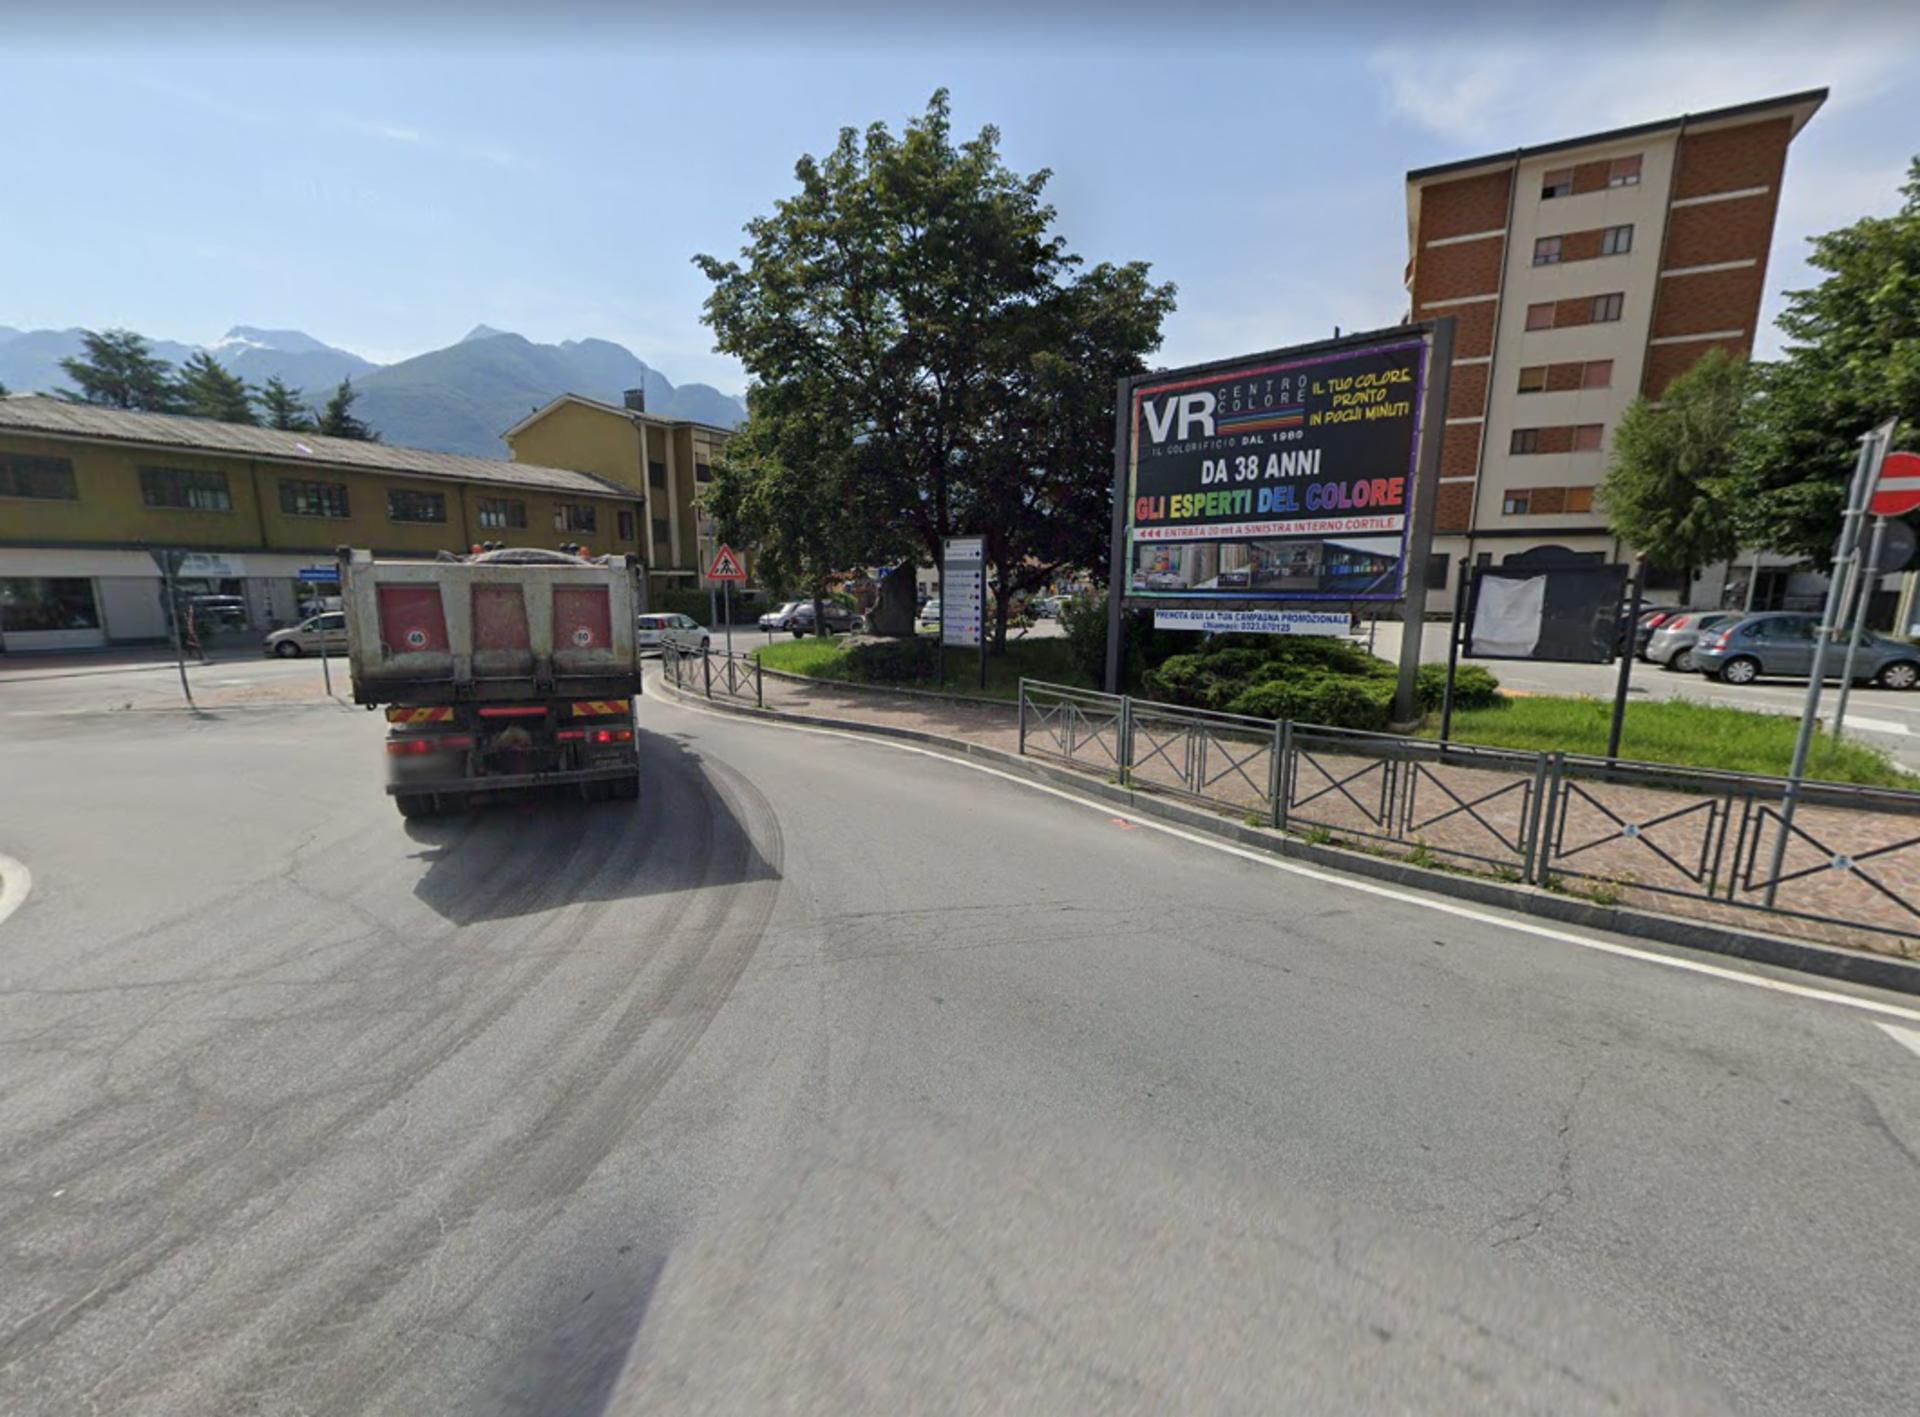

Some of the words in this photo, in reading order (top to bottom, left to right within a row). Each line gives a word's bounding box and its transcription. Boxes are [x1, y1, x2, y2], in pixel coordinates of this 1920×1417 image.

[1218, 374, 1307, 401] CENTRO
[1312, 382, 1326, 396] IL
[1328, 377, 1352, 393] TUO
[1353, 367, 1412, 389] COLORE
[1217, 388, 1305, 414] COLORE
[1333, 388, 1387, 407] PRONTO
[1142, 390, 1217, 444] VR
[1309, 414, 1324, 426] IN
[1325, 407, 1363, 424] POCHI
[1365, 401, 1410, 421] MINUTI
[1152, 447, 1163, 457] IL
[1167, 437, 1236, 455] COLORIFICIO
[1241, 434, 1264, 446] DAL
[1201, 458, 1229, 485] DA
[1234, 455, 1259, 481] 38
[1264, 448, 1321, 479] ANNI
[1135, 495, 1165, 521] GLI
[1169, 488, 1252, 519] ESPERTI
[1256, 484, 1300, 513] DEL
[1305, 476, 1406, 512] COLORE
[1164, 526, 1206, 537] ENTRATA
[1235, 524, 1243, 534] A
[1244, 521, 1292, 534] SINISTRA
[1294, 519, 1344, 532] INTERNO
[1344, 516, 1396, 530] CORTILE
[1280, 613, 1350, 624] PROMOZIONALE
